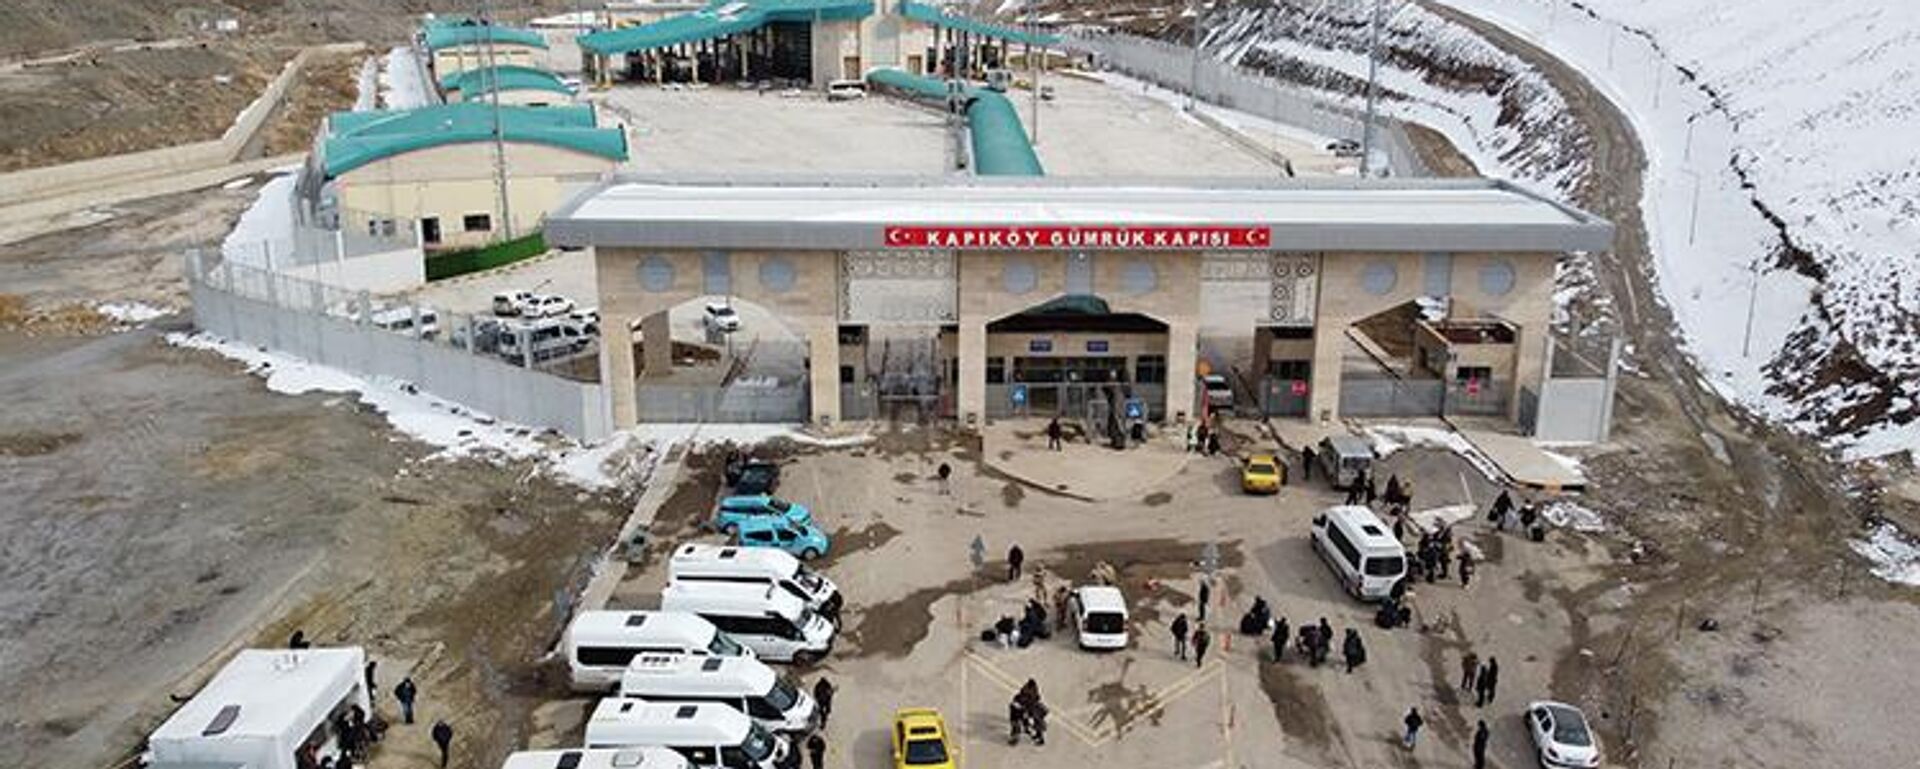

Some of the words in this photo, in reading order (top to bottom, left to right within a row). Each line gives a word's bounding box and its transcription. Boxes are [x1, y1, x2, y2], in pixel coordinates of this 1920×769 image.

[926, 228, 1039, 247] KAPIKÖY
[1050, 228, 1145, 247] GÜMRÜK
[1153, 230, 1230, 247] KAPISI
